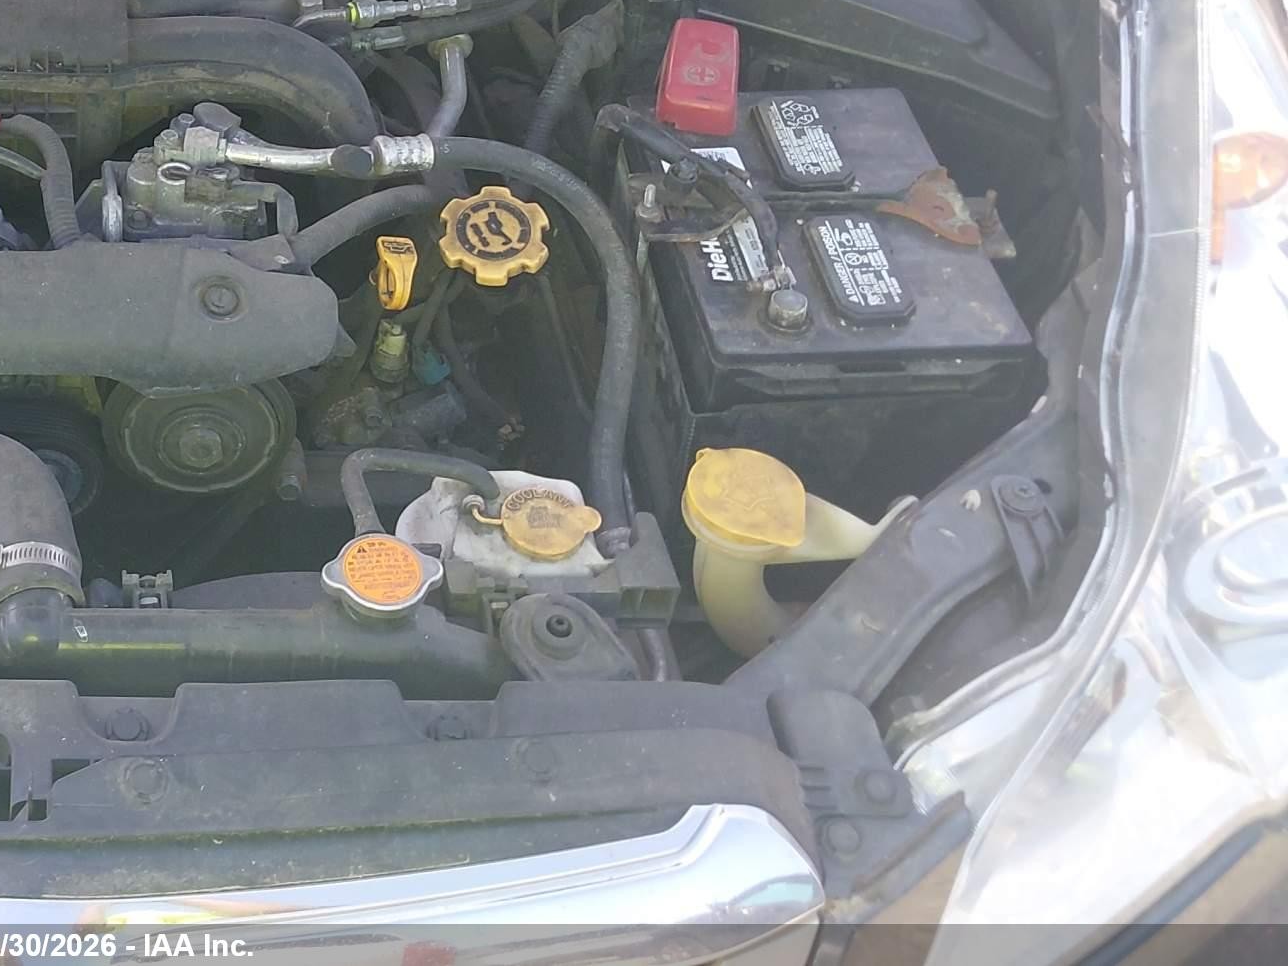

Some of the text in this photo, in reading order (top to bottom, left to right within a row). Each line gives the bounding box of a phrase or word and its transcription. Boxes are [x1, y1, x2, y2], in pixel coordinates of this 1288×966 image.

[817, 225, 838, 255] POISON
[699, 236, 734, 282] DieH
[833, 262, 856, 295] DANGER
